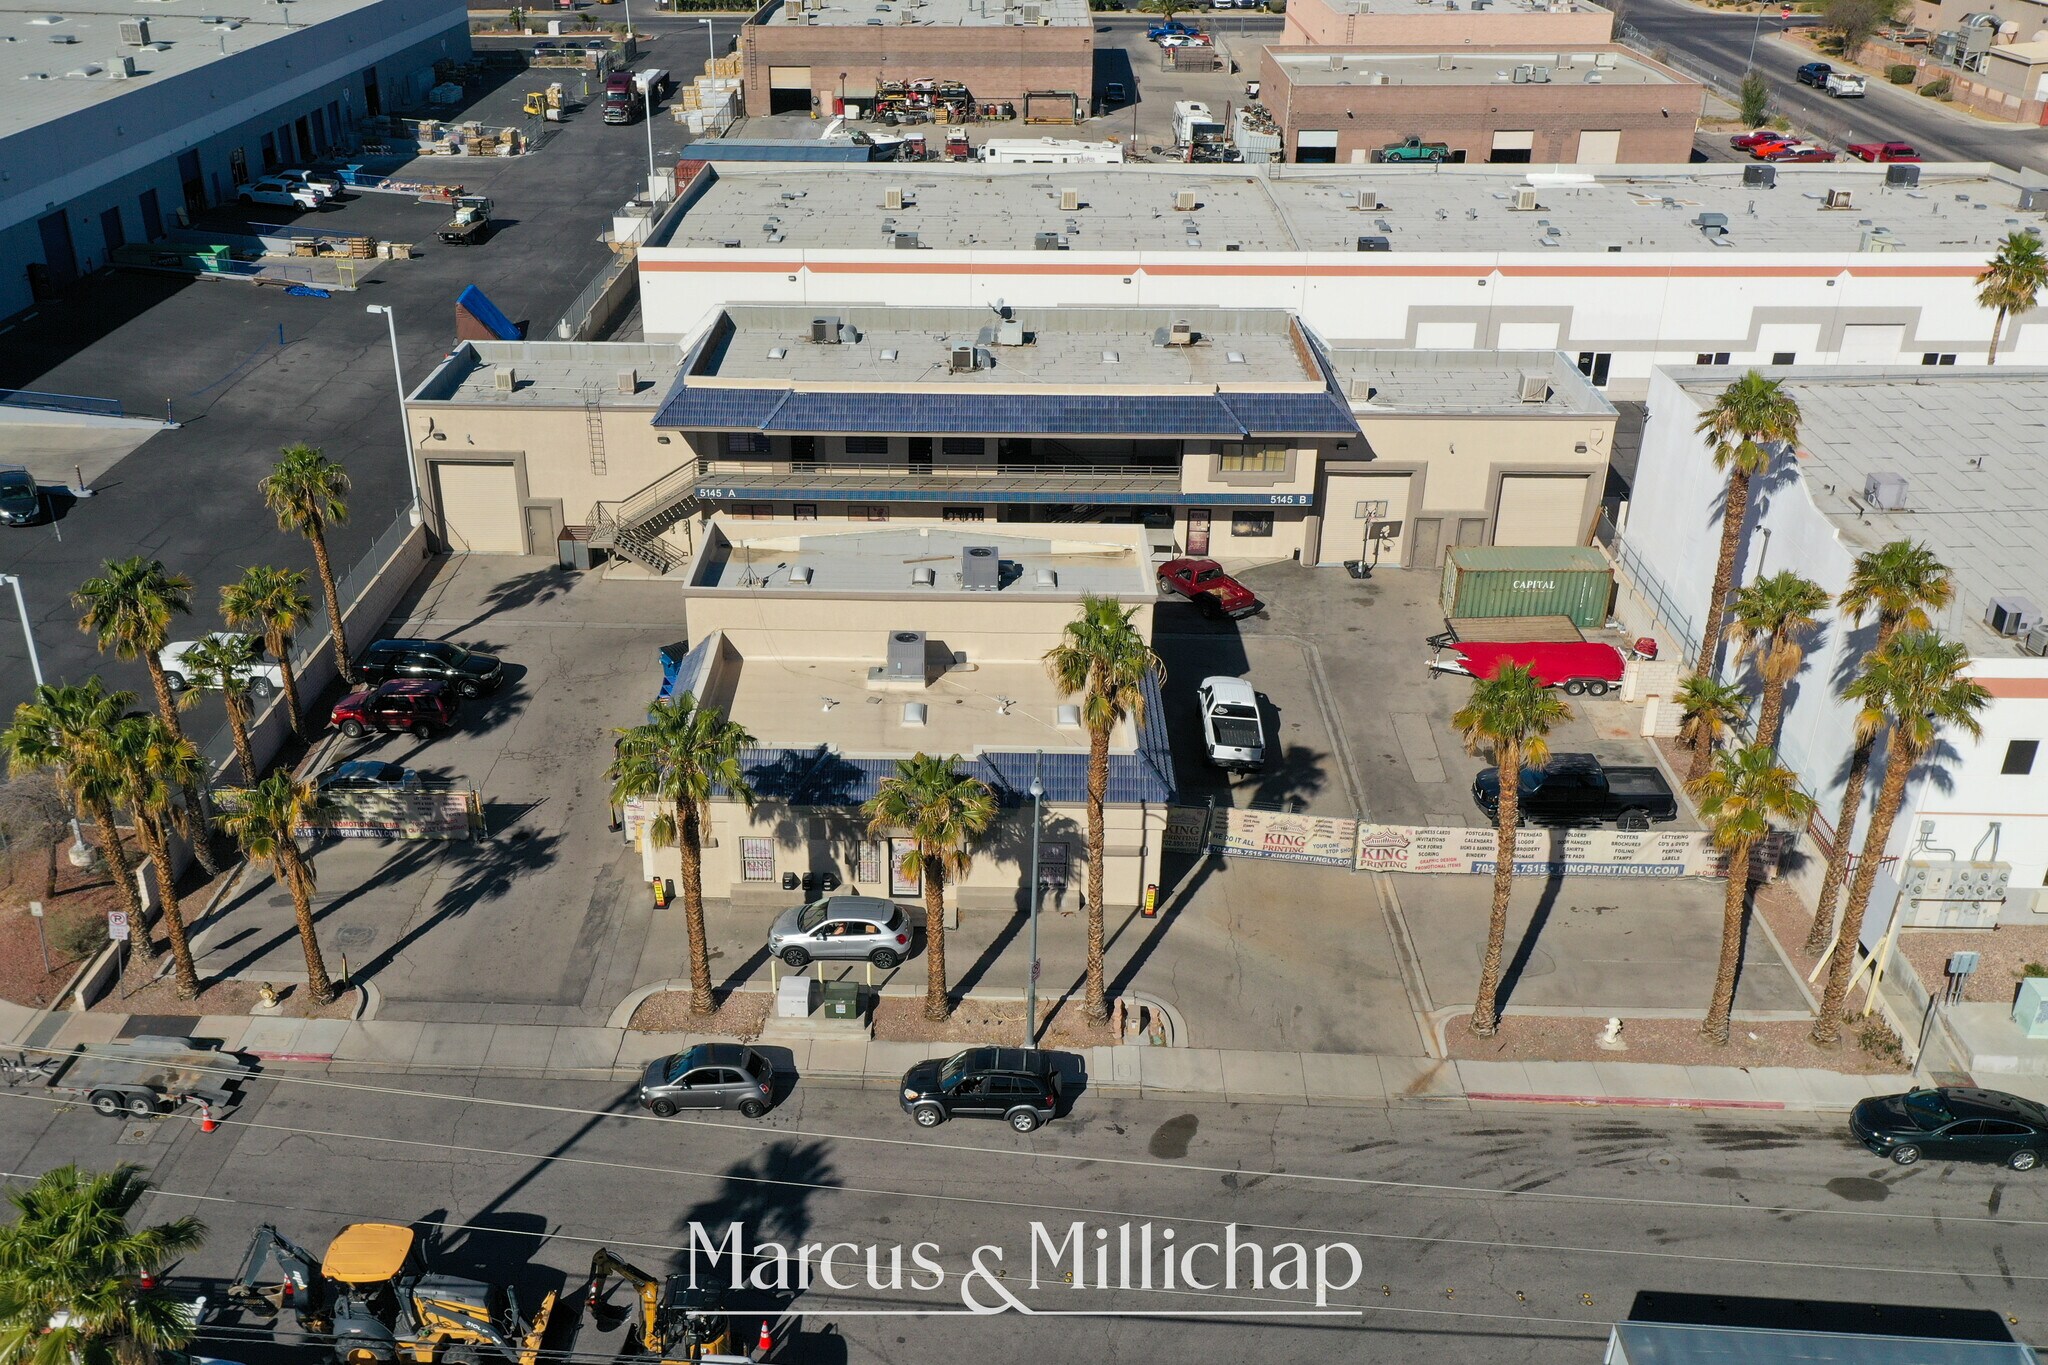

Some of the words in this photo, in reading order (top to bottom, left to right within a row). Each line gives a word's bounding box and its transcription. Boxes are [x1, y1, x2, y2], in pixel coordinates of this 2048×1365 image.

[700, 489, 722, 497] 5145
[728, 489, 736, 497] A
[1270, 495, 1293, 504] 5145
[1299, 496, 1306, 504] B
[1513, 580, 1555, 589] CAPITAL
[1264, 833, 1306, 846] KING
[1262, 845, 1304, 853] PRINTING
[1361, 848, 1408, 860] KING
[1360, 860, 1407, 868] PRINTING
[1558, 865, 1678, 875] KINGPRINTINGLV.COM
